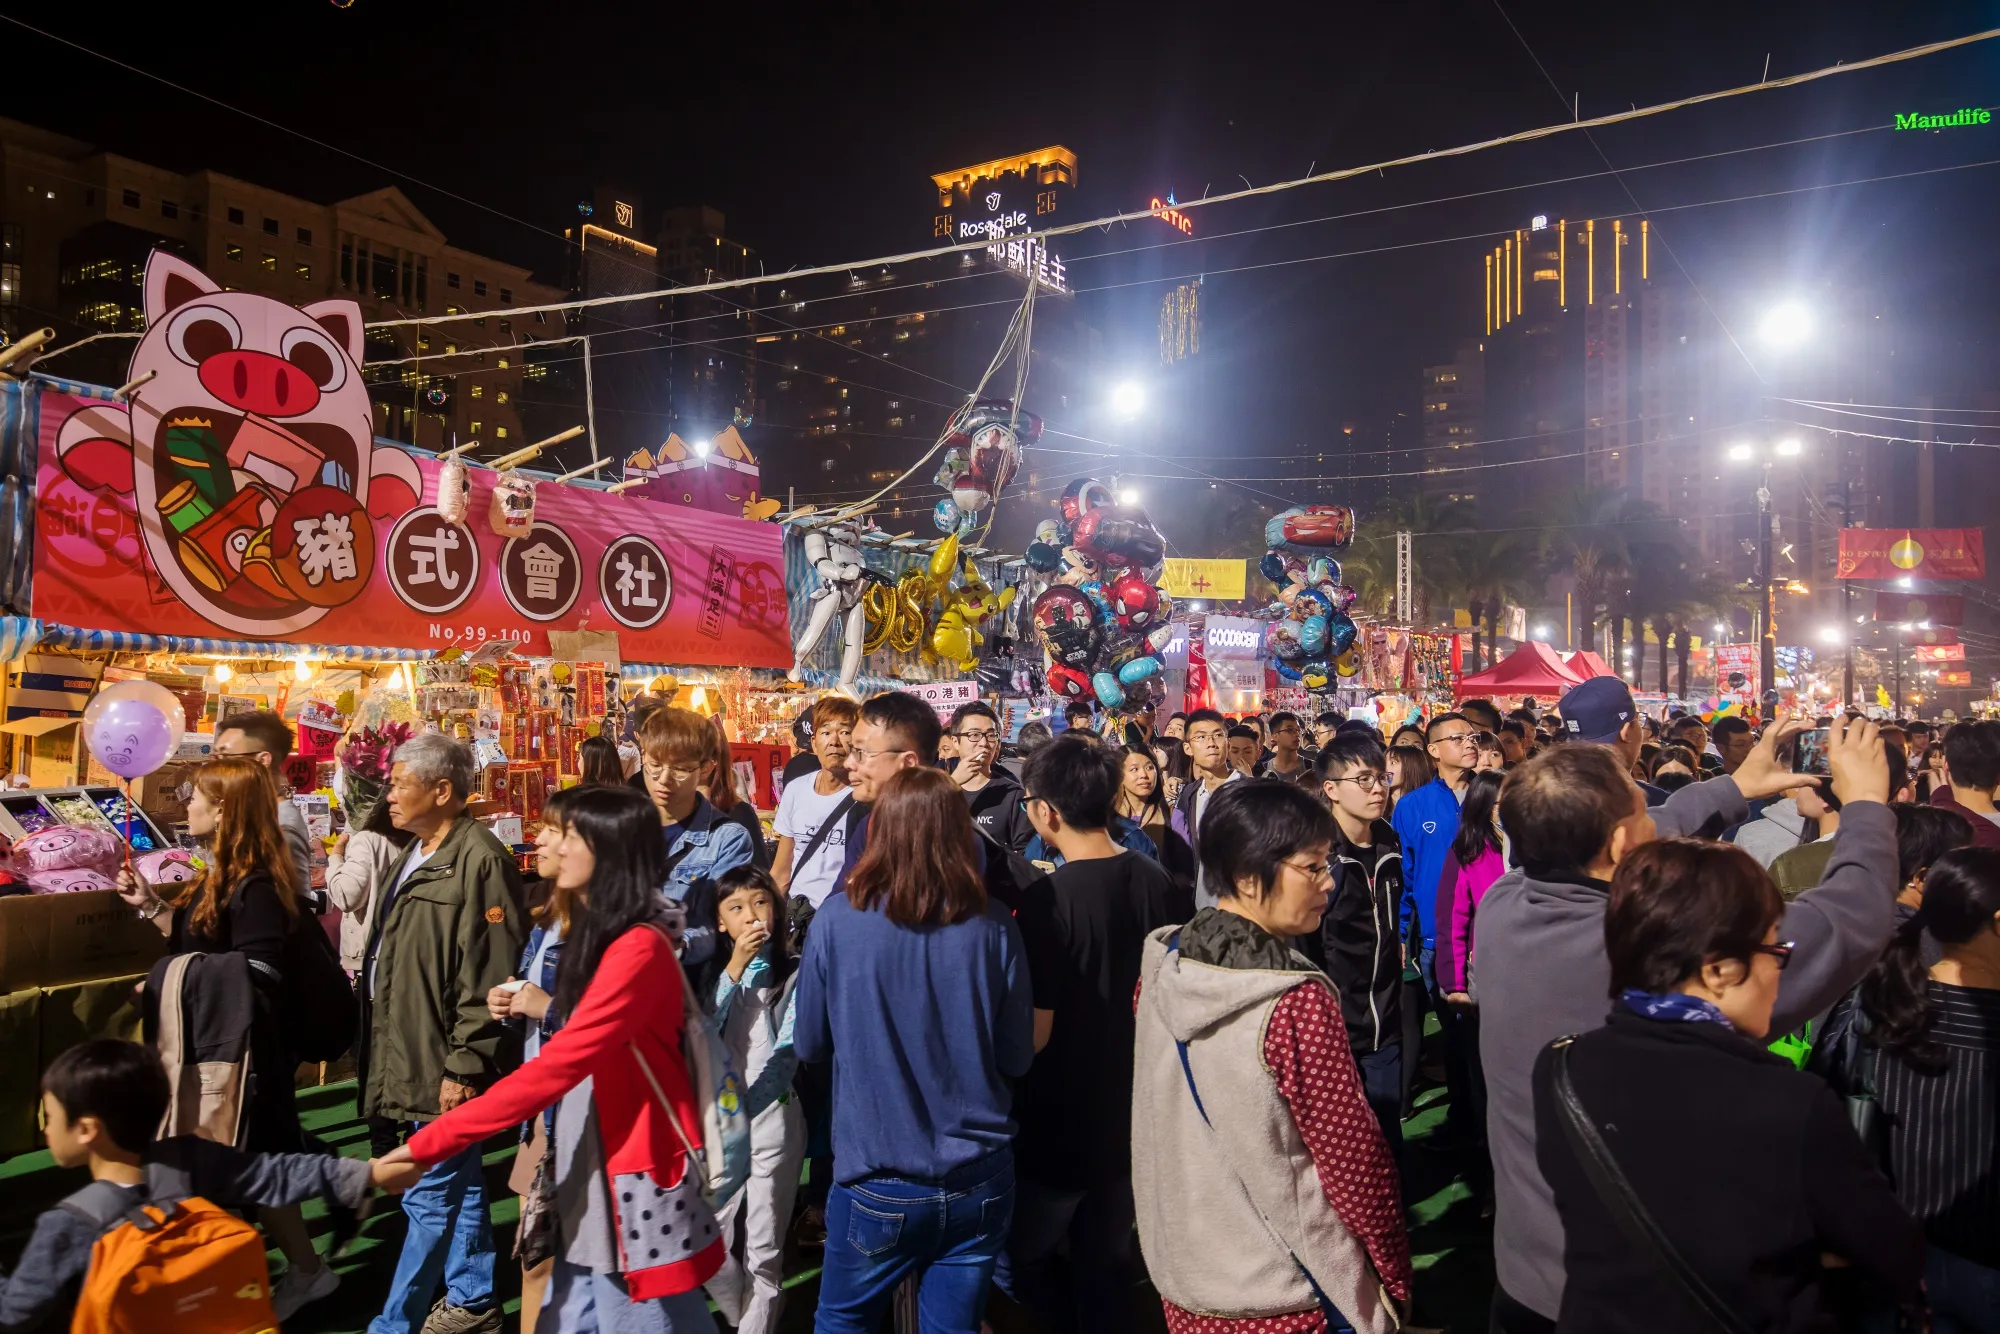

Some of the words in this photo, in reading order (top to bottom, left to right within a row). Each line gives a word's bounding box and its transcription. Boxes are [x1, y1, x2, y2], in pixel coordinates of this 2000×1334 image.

[1895, 108, 1990, 131] Manulife
[960, 210, 1027, 238] Rosedale
[64, 679, 92, 689] HARIBO
[976, 815, 994, 825] NYC
